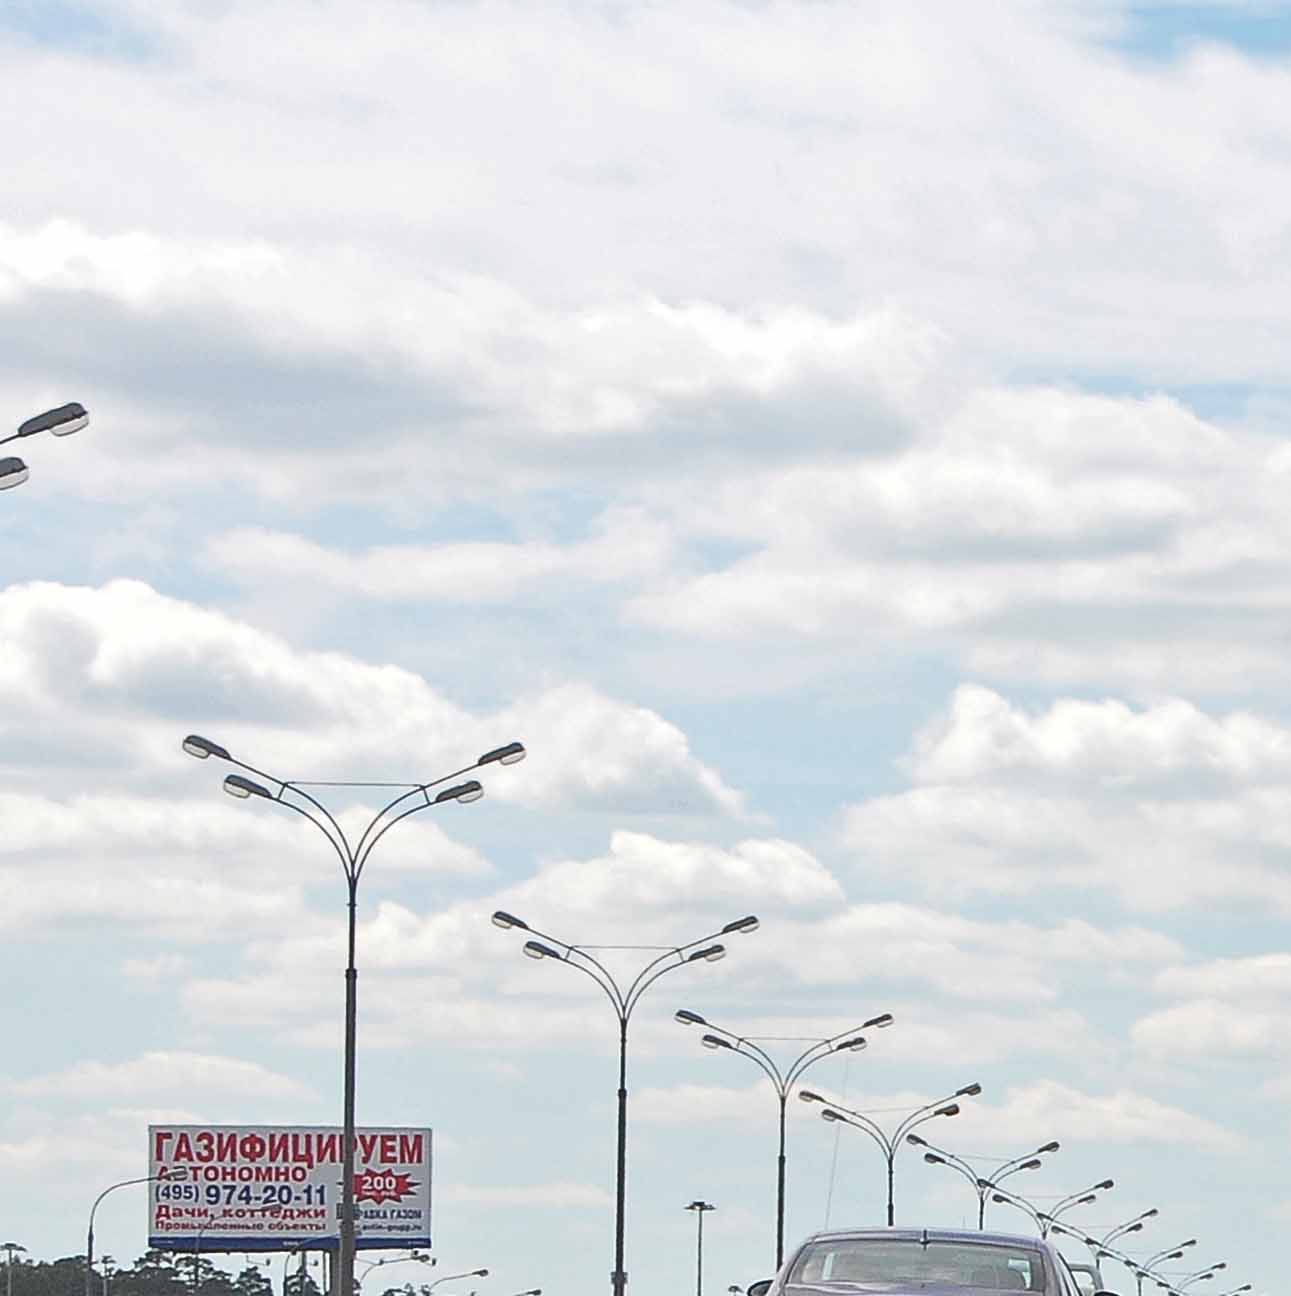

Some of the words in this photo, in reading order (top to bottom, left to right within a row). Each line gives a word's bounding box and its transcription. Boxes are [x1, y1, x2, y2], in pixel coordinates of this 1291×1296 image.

[362, 1175, 398, 1190] 200
[155, 1185, 200, 1202] (495)
[205, 1184, 326, 1205] 974-20-11
[222, 1206, 326, 1220] коттеджи
[268, 1220, 326, 1232] объекты
